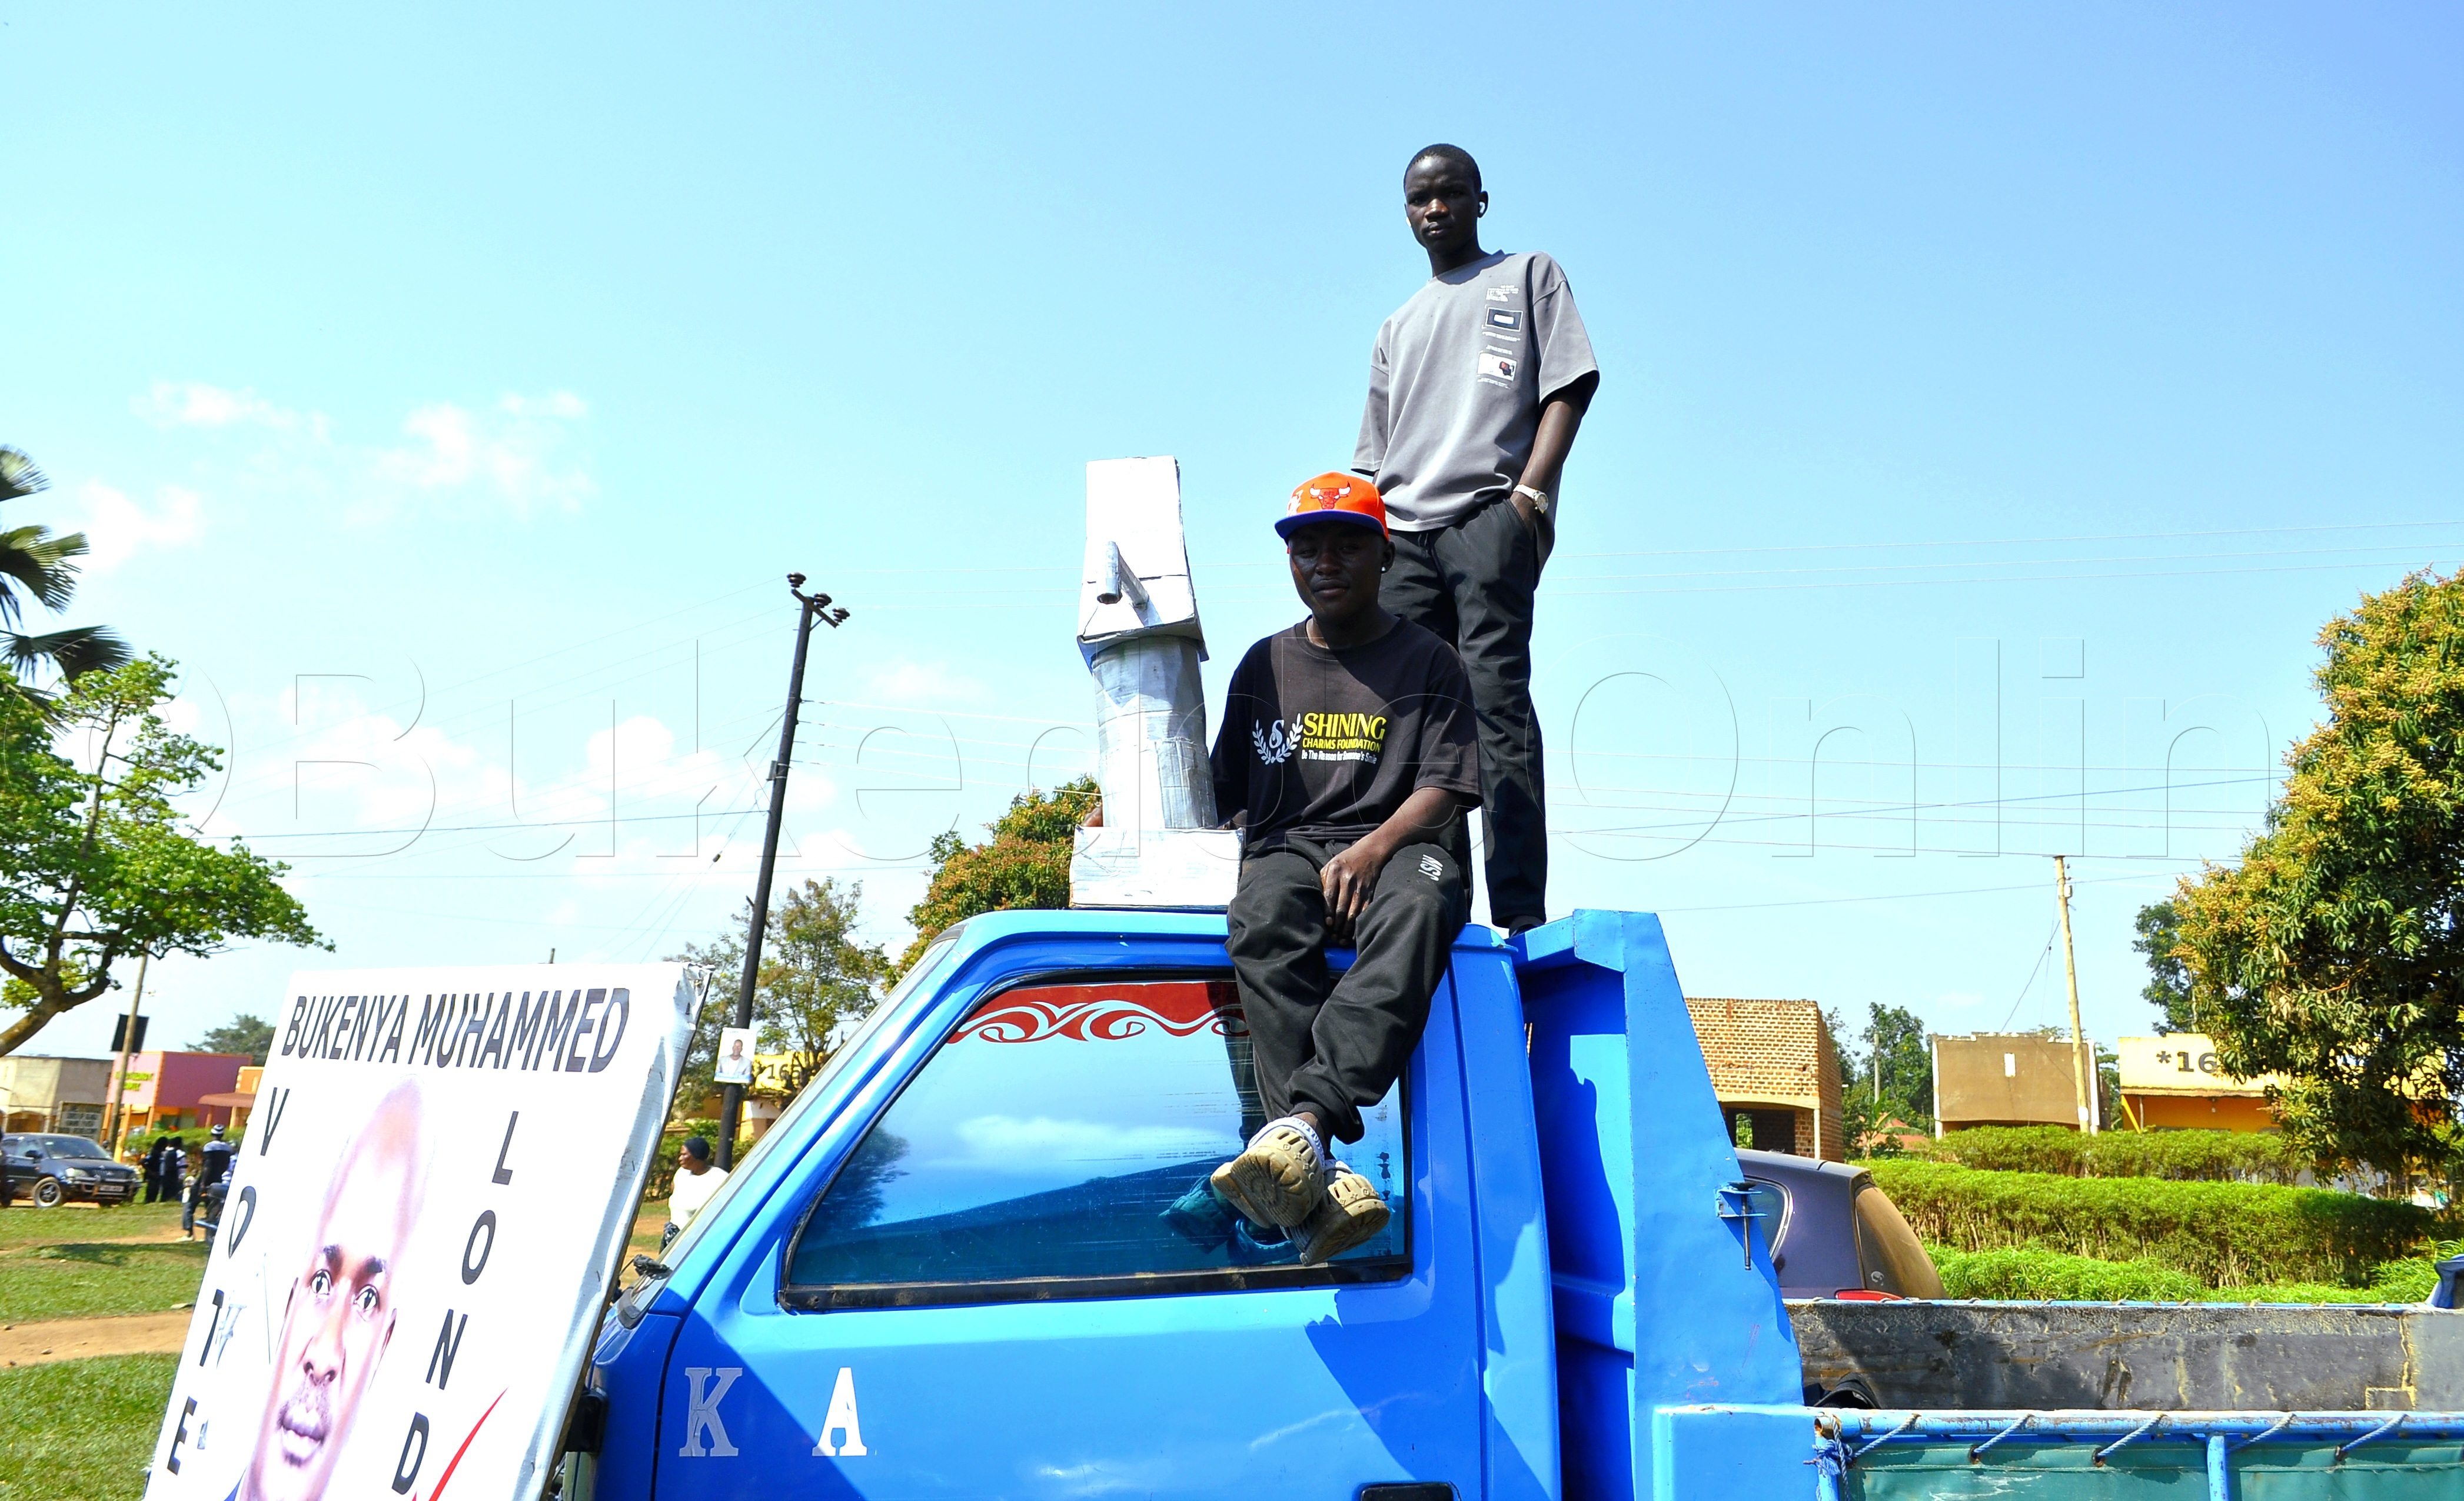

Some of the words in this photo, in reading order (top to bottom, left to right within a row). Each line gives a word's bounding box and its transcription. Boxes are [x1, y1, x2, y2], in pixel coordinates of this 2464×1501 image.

[1303, 713, 1387, 740] SHINING
[1301, 750, 1308, 760] Be
[1308, 750, 1318, 760] The
[1318, 750, 1336, 761] Reason
[1302, 737, 1336, 750] CHARMS
[1336, 738, 1381, 753] FOUNDATION
[281, 995, 410, 1064] BUKENYA
[407, 988, 630, 1073] MUHAMMED
